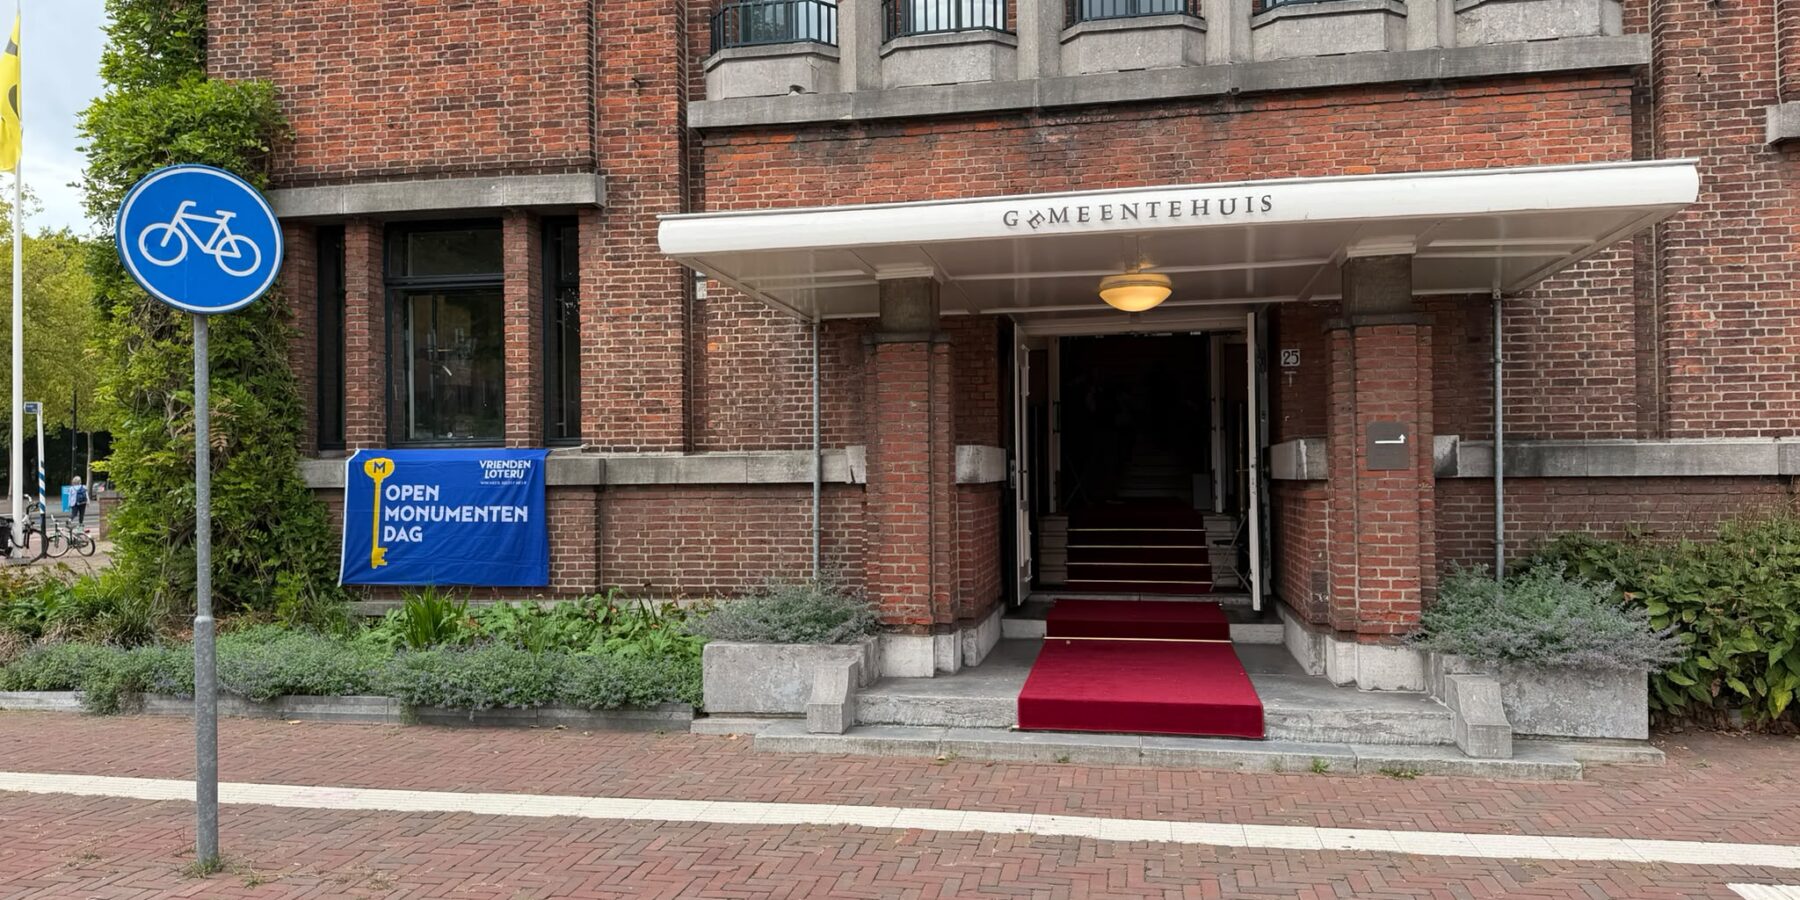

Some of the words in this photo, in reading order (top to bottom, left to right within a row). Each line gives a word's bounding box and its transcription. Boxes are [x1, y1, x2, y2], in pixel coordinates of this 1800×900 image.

[1003, 194, 1273, 231] GEMEENTEHUIS
[1282, 350, 1299, 365] 25
[373, 461, 386, 474] M
[479, 459, 531, 469] VRIENDEN
[385, 484, 440, 502] OPEN
[384, 505, 528, 523] MONUMENTEN
[383, 525, 423, 543] DAG
